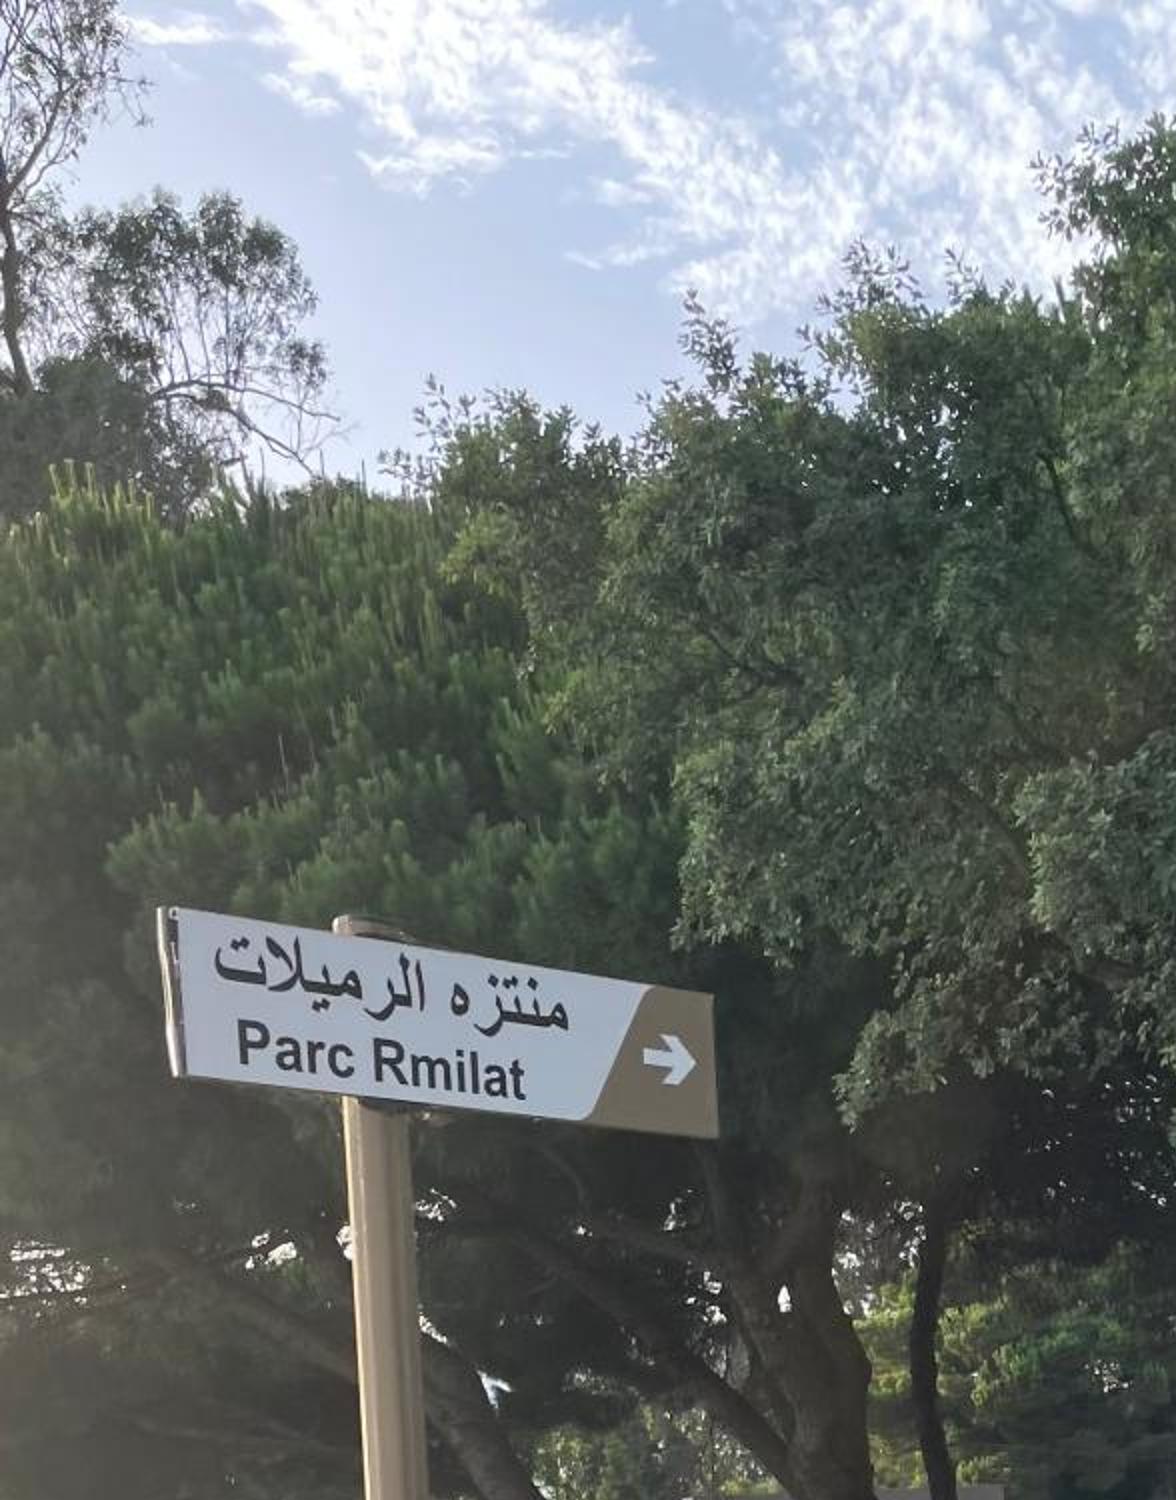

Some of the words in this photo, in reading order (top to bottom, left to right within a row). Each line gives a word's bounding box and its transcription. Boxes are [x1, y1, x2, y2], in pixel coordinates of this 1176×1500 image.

[214, 936, 425, 1022] الرميلات
[450, 974, 569, 1038] منتزه
[237, 1018, 355, 1079] Parc
[373, 1037, 526, 1101] Rmilat
